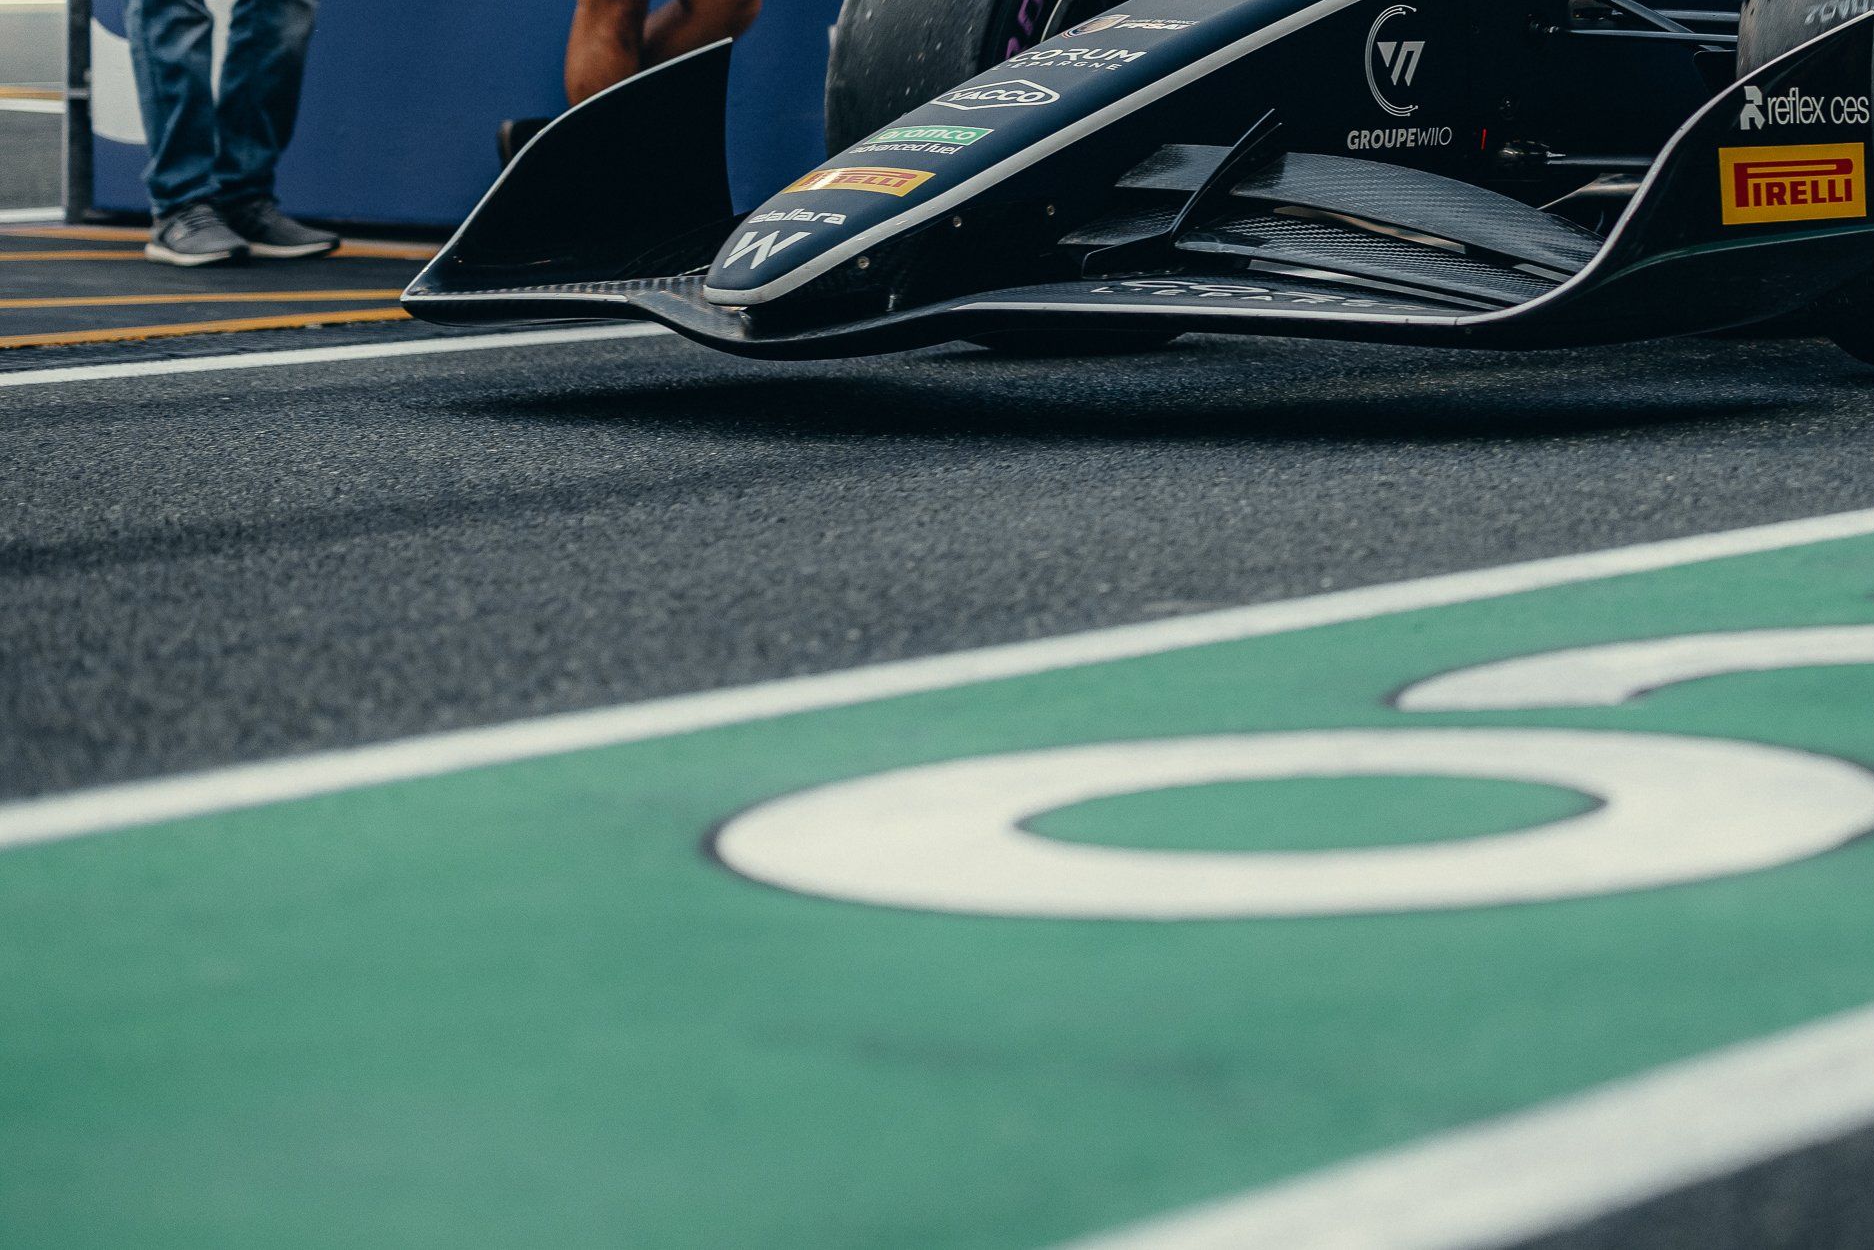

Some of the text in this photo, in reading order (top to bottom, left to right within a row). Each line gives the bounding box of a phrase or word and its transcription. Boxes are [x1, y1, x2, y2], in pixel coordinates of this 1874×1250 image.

[1008, 48, 1148, 63] CORUM
[948, 88, 1043, 103] YACCO
[1767, 87, 1826, 125] reflex
[1830, 96, 1870, 125] ces
[877, 127, 978, 142] aramco
[848, 142, 964, 156] advanced fuel
[799, 167, 917, 190] PIRELLI
[1733, 158, 1854, 208] PIRELLI
[747, 207, 848, 226] dallara
